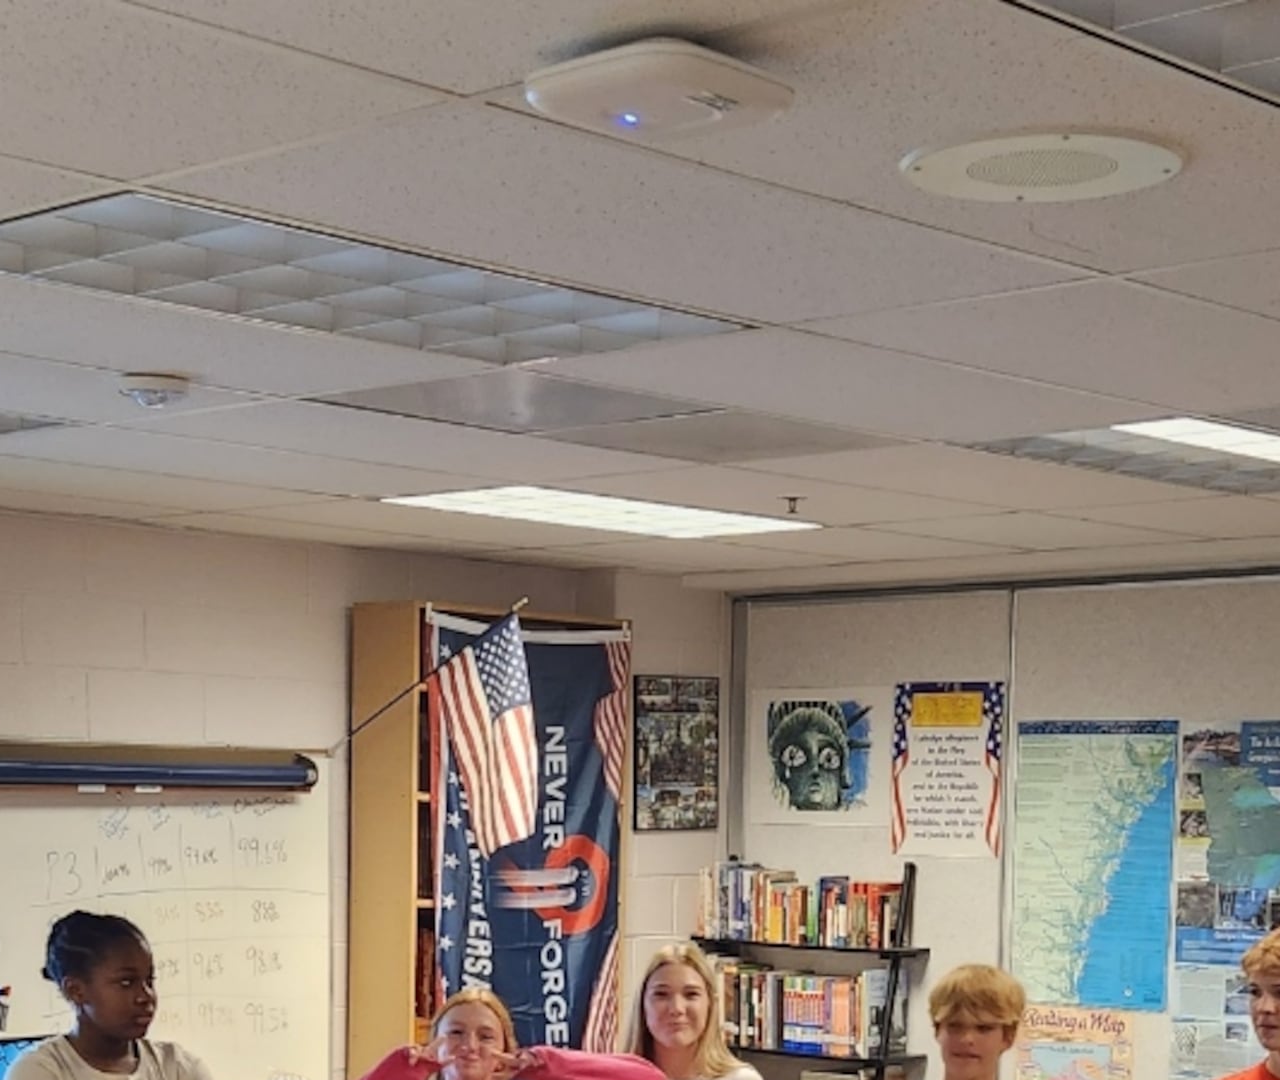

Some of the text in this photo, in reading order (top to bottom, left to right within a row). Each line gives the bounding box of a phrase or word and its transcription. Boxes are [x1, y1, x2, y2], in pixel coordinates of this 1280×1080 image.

[463, 828, 494, 993] ANNIVERSA
[541, 726, 572, 1050] NEVER FORGE
[1024, 1008, 1077, 1034] Reading
[1090, 1012, 1126, 1038] Map
